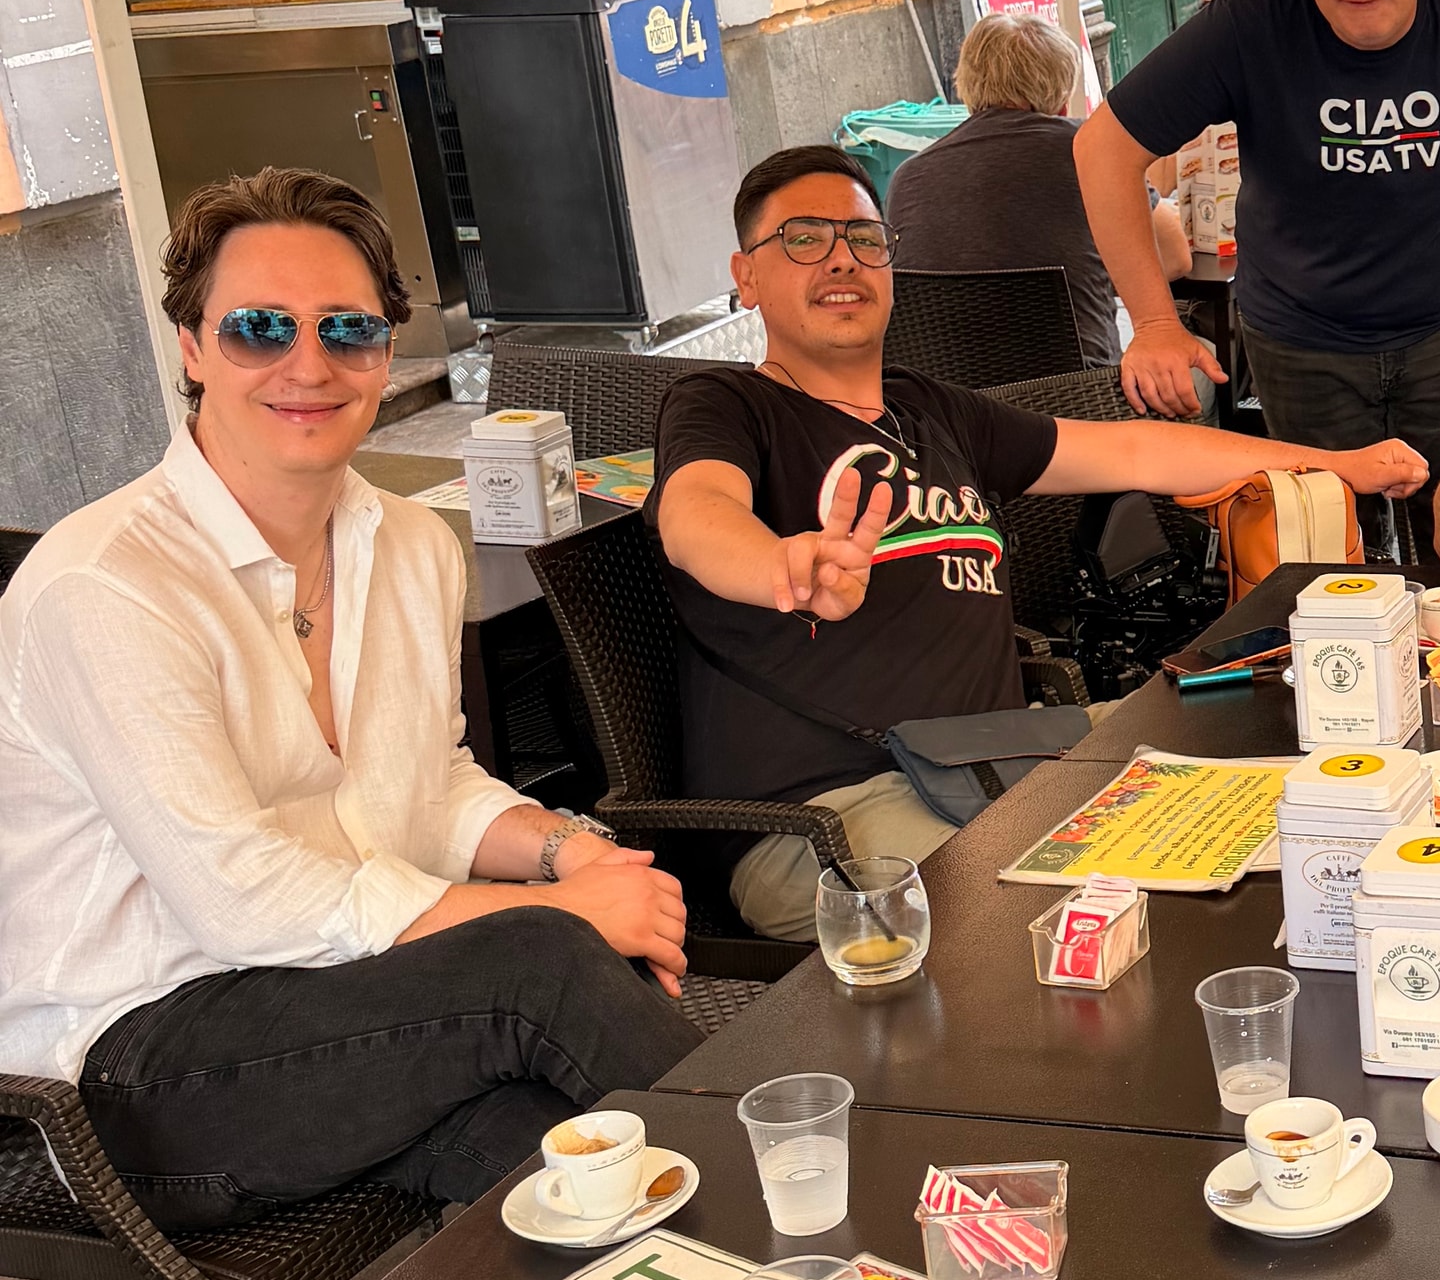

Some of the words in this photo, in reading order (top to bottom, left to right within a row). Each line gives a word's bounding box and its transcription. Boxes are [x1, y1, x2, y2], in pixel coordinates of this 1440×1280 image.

[649, 25, 674, 47] PORETTI
[1319, 90, 1440, 136] CIAO
[818, 443, 991, 536] Ciao
[937, 555, 1003, 595] USA
[1312, 645, 1336, 668] EPOQUE
[1356, 656, 1366, 671] 165
[1377, 944, 1408, 976] EPOQUE
